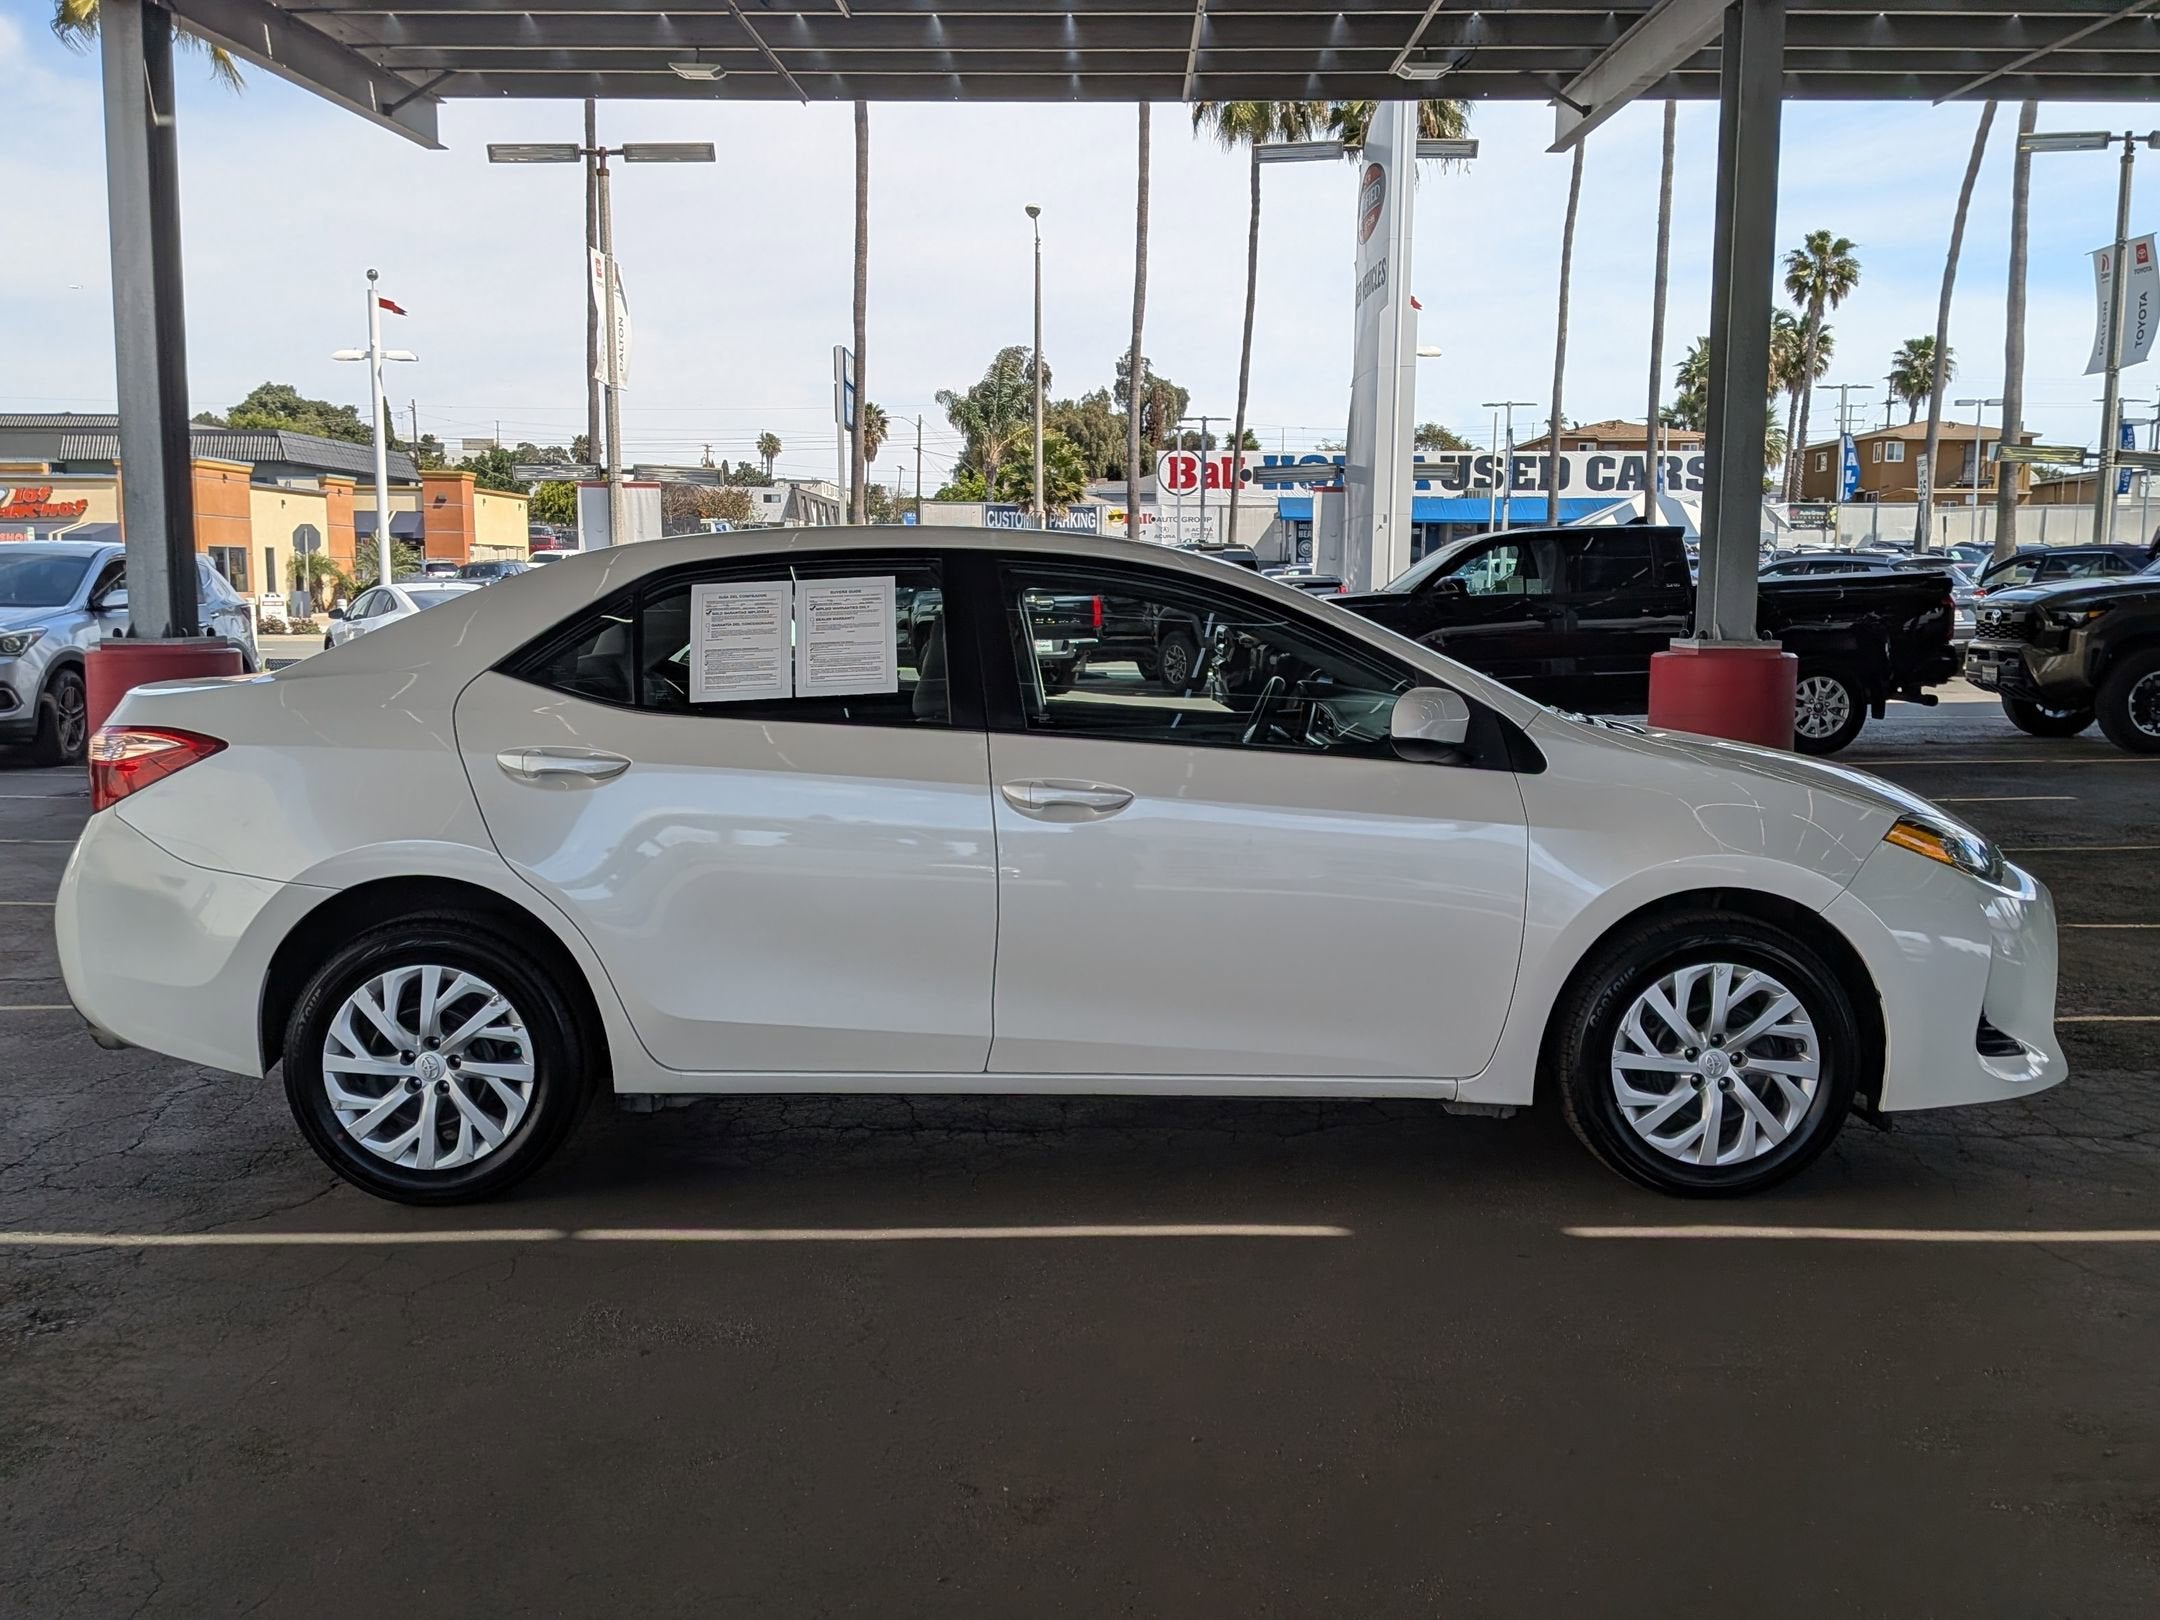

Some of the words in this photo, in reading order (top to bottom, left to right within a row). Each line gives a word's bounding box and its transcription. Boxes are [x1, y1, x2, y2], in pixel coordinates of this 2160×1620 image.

[2135, 291, 2148, 349] TOYOTA
[1440, 455, 1571, 491] USED
[1586, 455, 1705, 492] CARS
